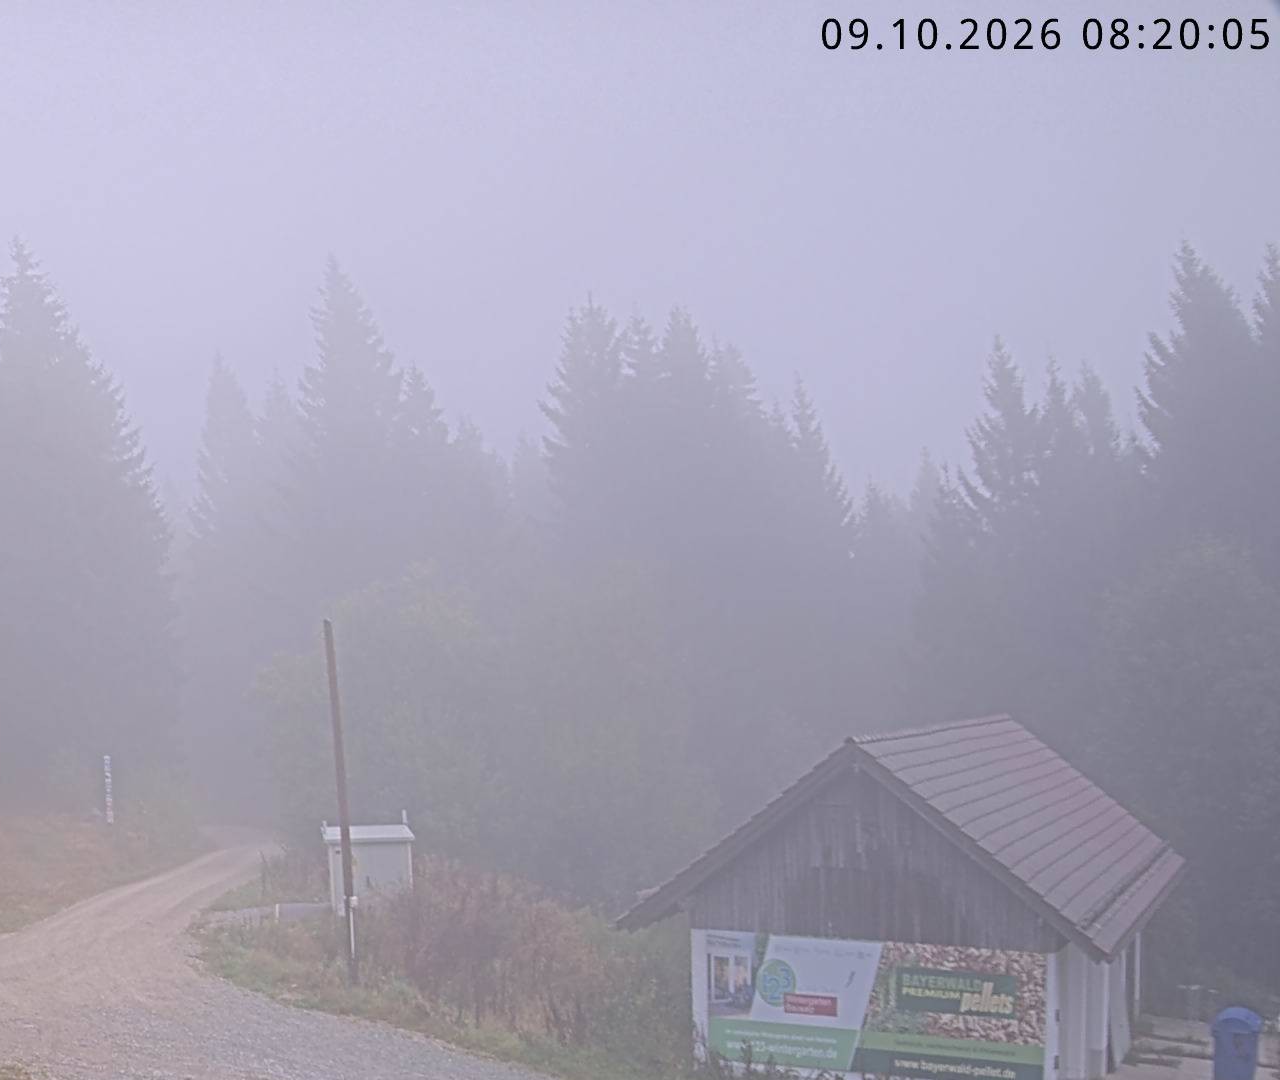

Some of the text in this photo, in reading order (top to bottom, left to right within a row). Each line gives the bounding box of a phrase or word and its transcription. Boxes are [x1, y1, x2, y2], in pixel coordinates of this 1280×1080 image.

[902, 973, 983, 992] BAYERWALD
[901, 987, 961, 1000] PREMIUM
[959, 981, 1015, 1014] pellets
